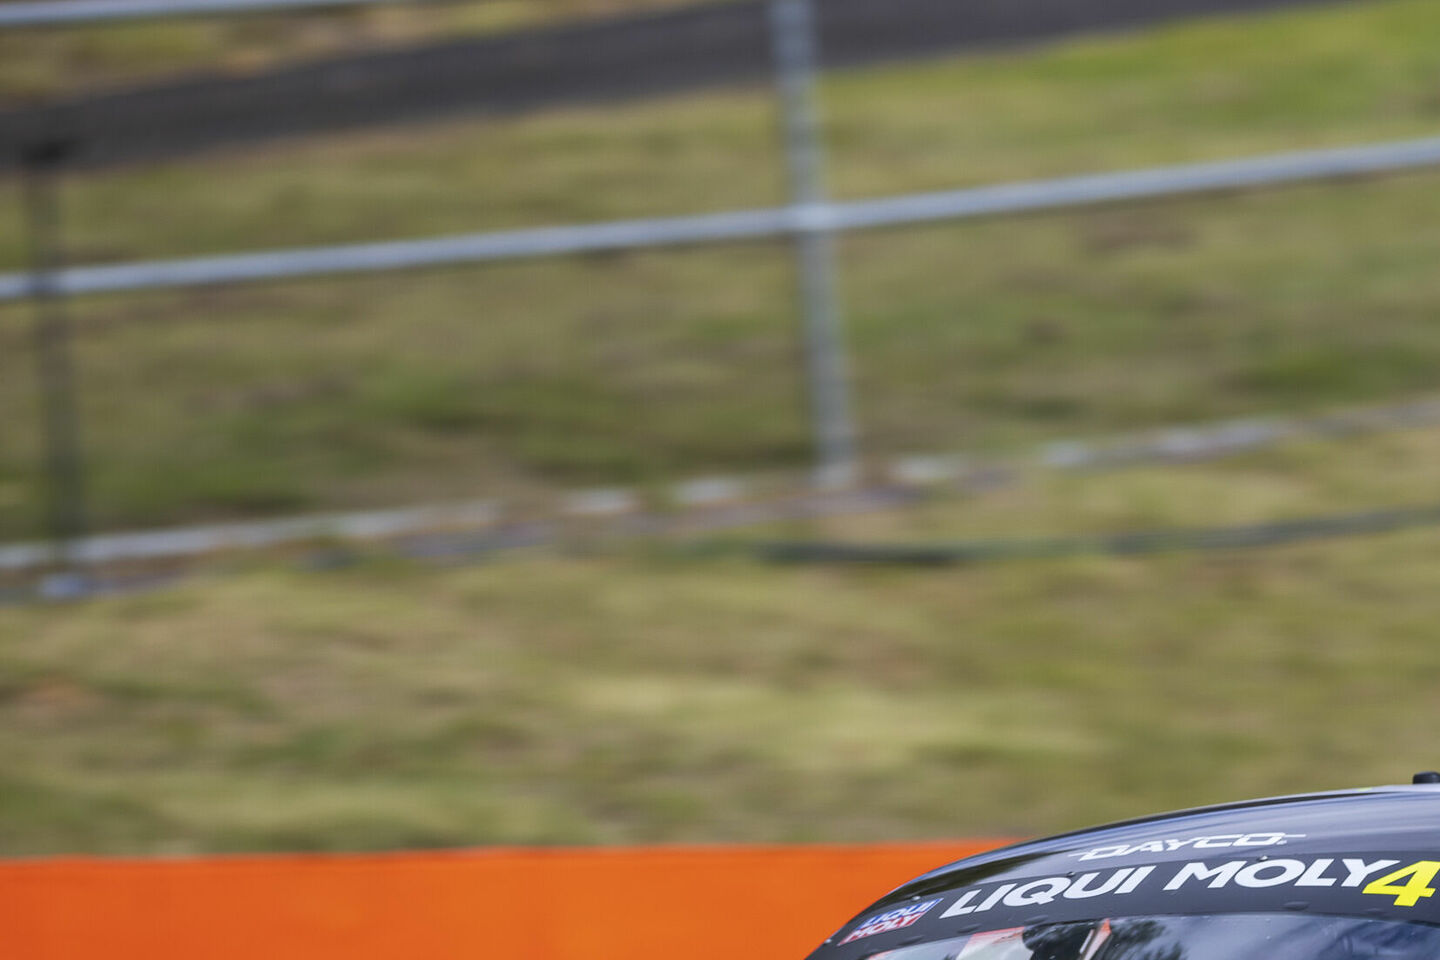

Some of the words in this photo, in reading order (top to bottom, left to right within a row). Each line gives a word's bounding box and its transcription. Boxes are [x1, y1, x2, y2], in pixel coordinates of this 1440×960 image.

[1068, 831, 1306, 862] DAYCO
[939, 865, 1157, 919] LIQUI
[1163, 858, 1401, 891] MOLY
[844, 912, 922, 942] MOLY
[861, 899, 936, 929] LIQUI
